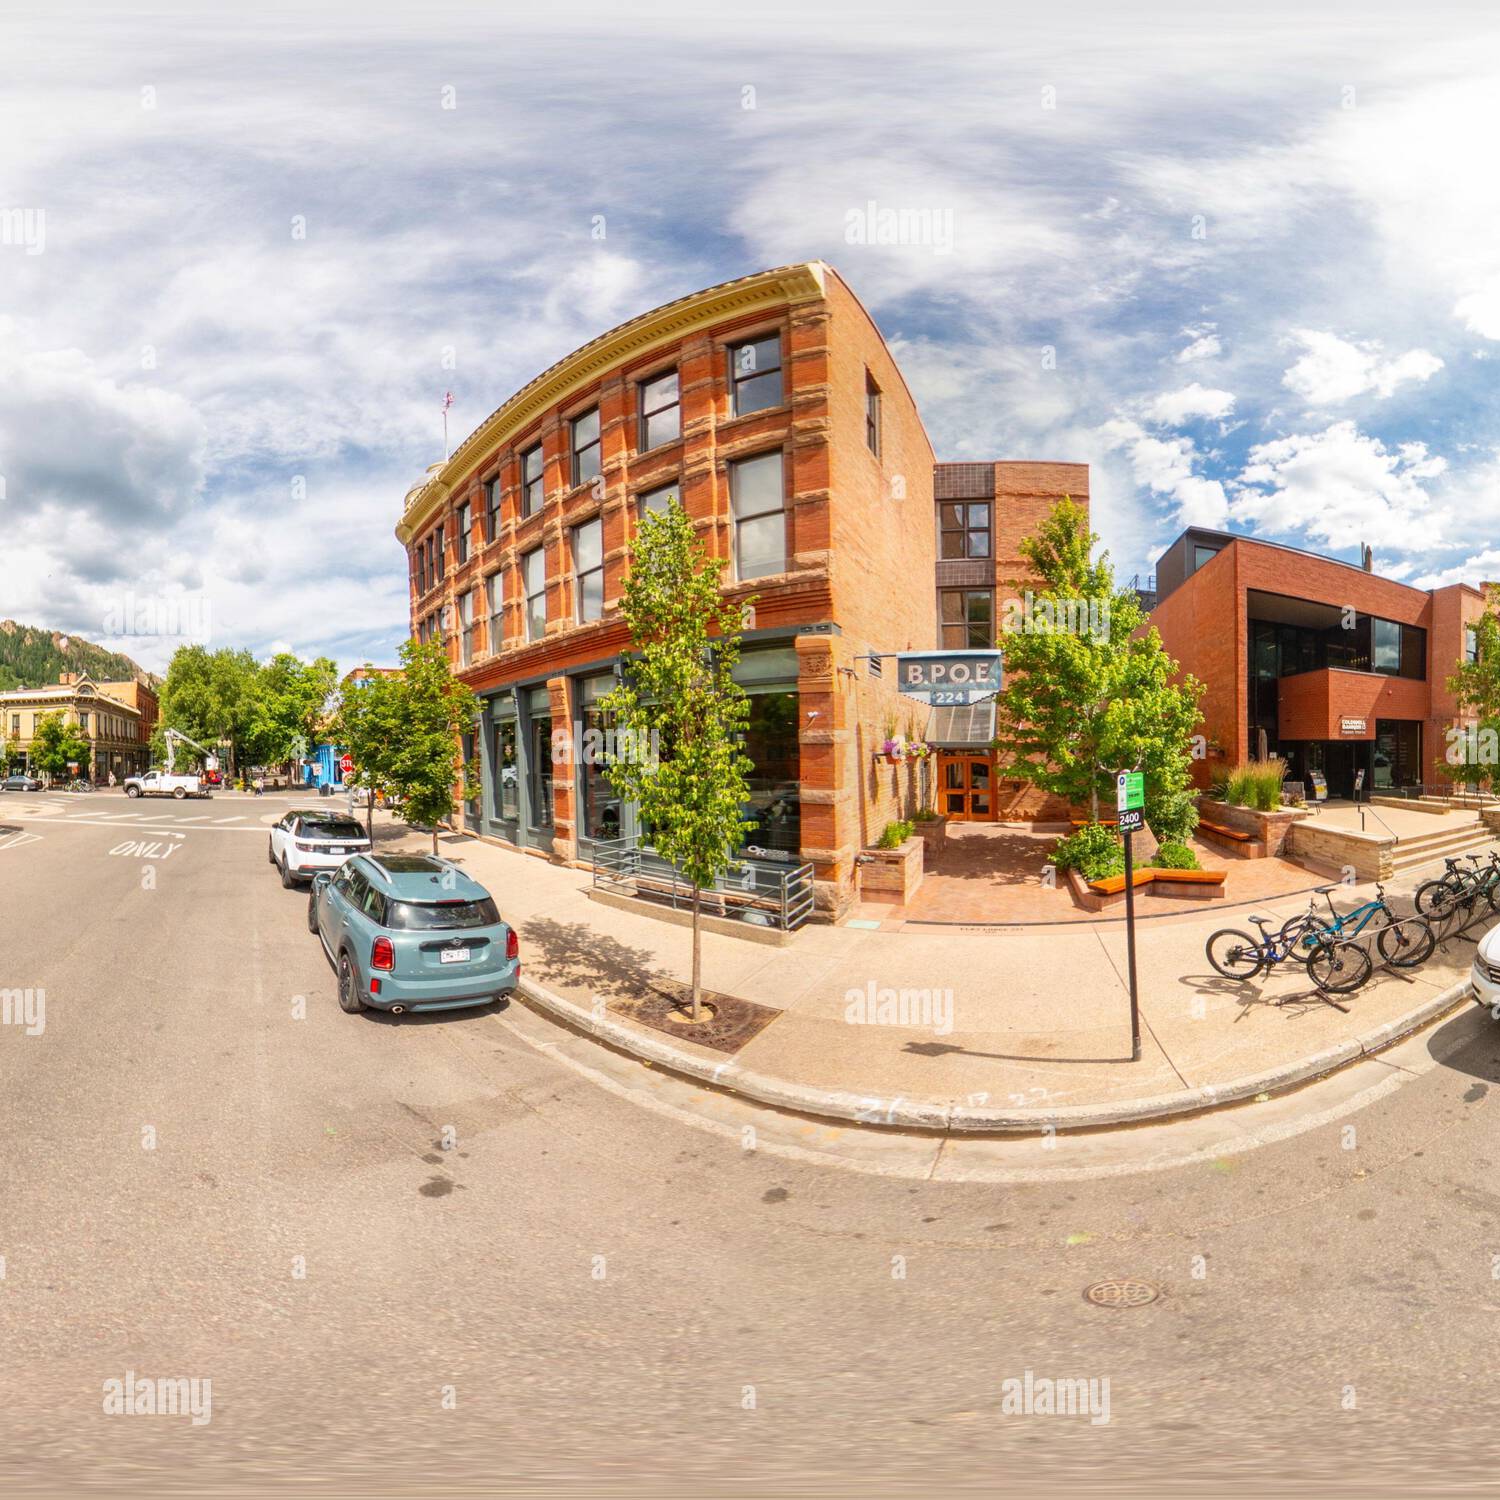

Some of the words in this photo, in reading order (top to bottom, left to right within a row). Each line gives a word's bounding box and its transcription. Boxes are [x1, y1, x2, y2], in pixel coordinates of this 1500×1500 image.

[936, 693, 963, 703] 224
[1120, 812, 1140, 826] 2400
[108, 840, 183, 858] ONLY
